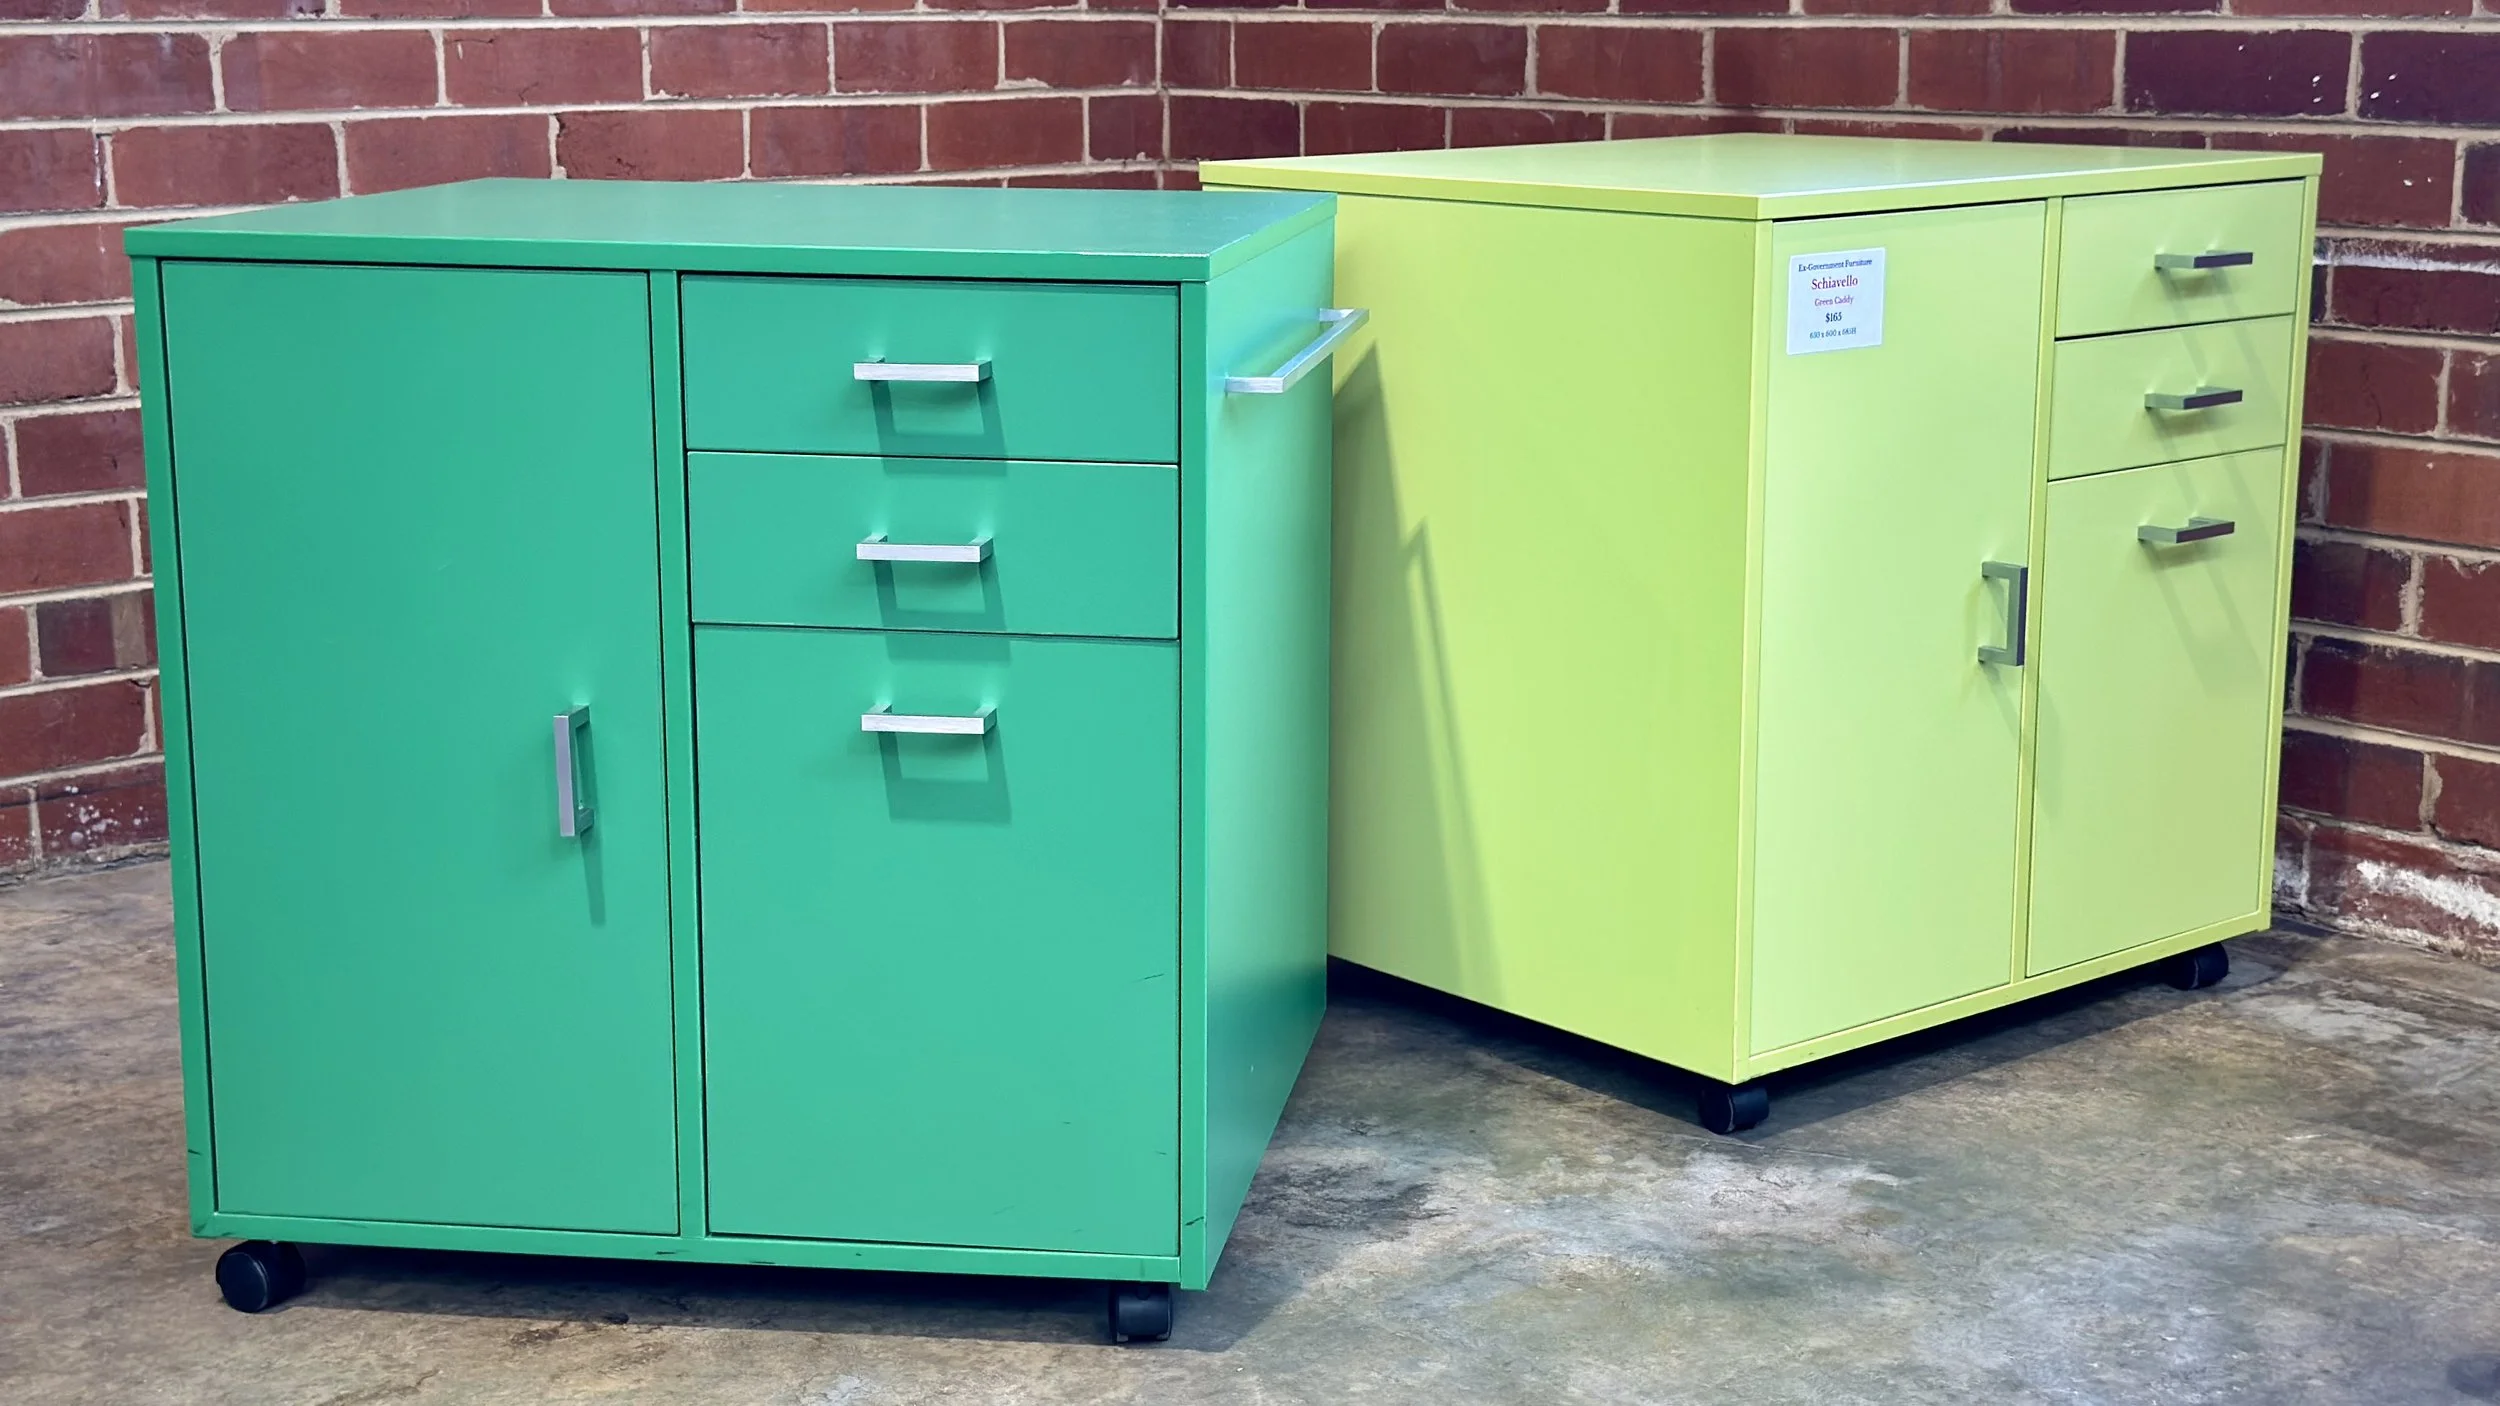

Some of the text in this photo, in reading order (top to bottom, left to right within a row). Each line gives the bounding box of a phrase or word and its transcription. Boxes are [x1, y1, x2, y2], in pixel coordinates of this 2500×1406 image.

[1798, 259, 1873, 272] Ex-Government Furniture
[1811, 274, 1859, 290] Schiavello
[1814, 295, 1854, 307] Green Caddy
[1825, 311, 1843, 323] $165
